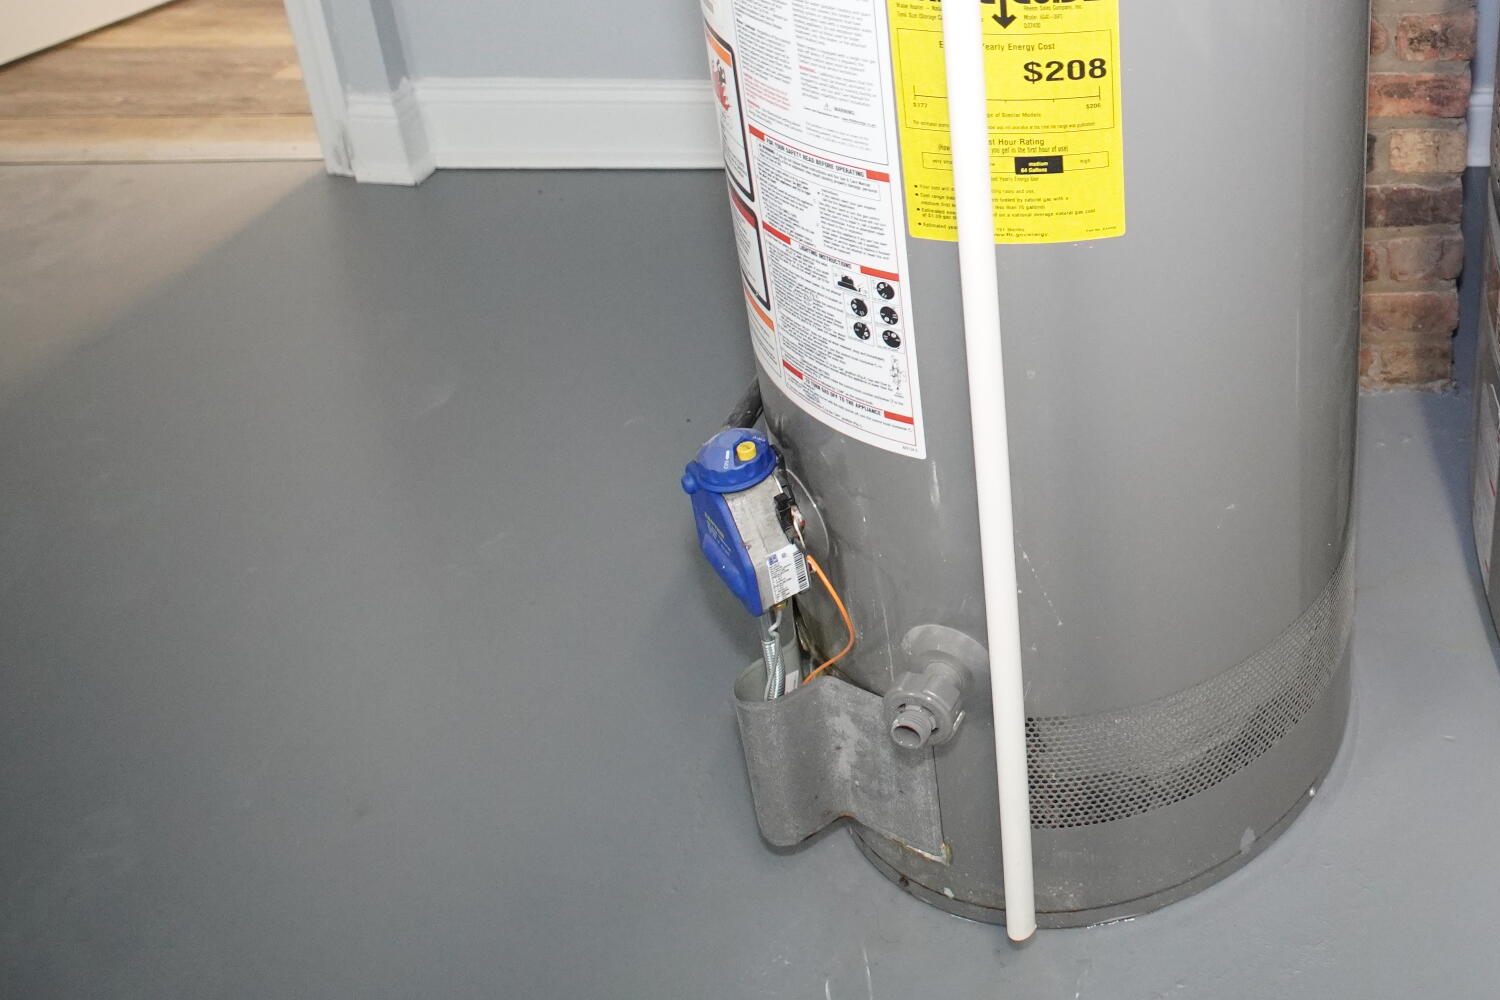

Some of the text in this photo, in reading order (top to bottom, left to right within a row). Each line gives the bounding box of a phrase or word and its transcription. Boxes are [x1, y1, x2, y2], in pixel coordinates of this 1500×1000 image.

[1008, 43, 1035, 52] Energy
[1038, 42, 1056, 50] Cost
[1023, 58, 1107, 84] $208
[998, 138, 1017, 146] Hour
[1019, 138, 1045, 147] Rating
[785, 147, 802, 158] SAFETY
[815, 158, 834, 170] BEFORE
